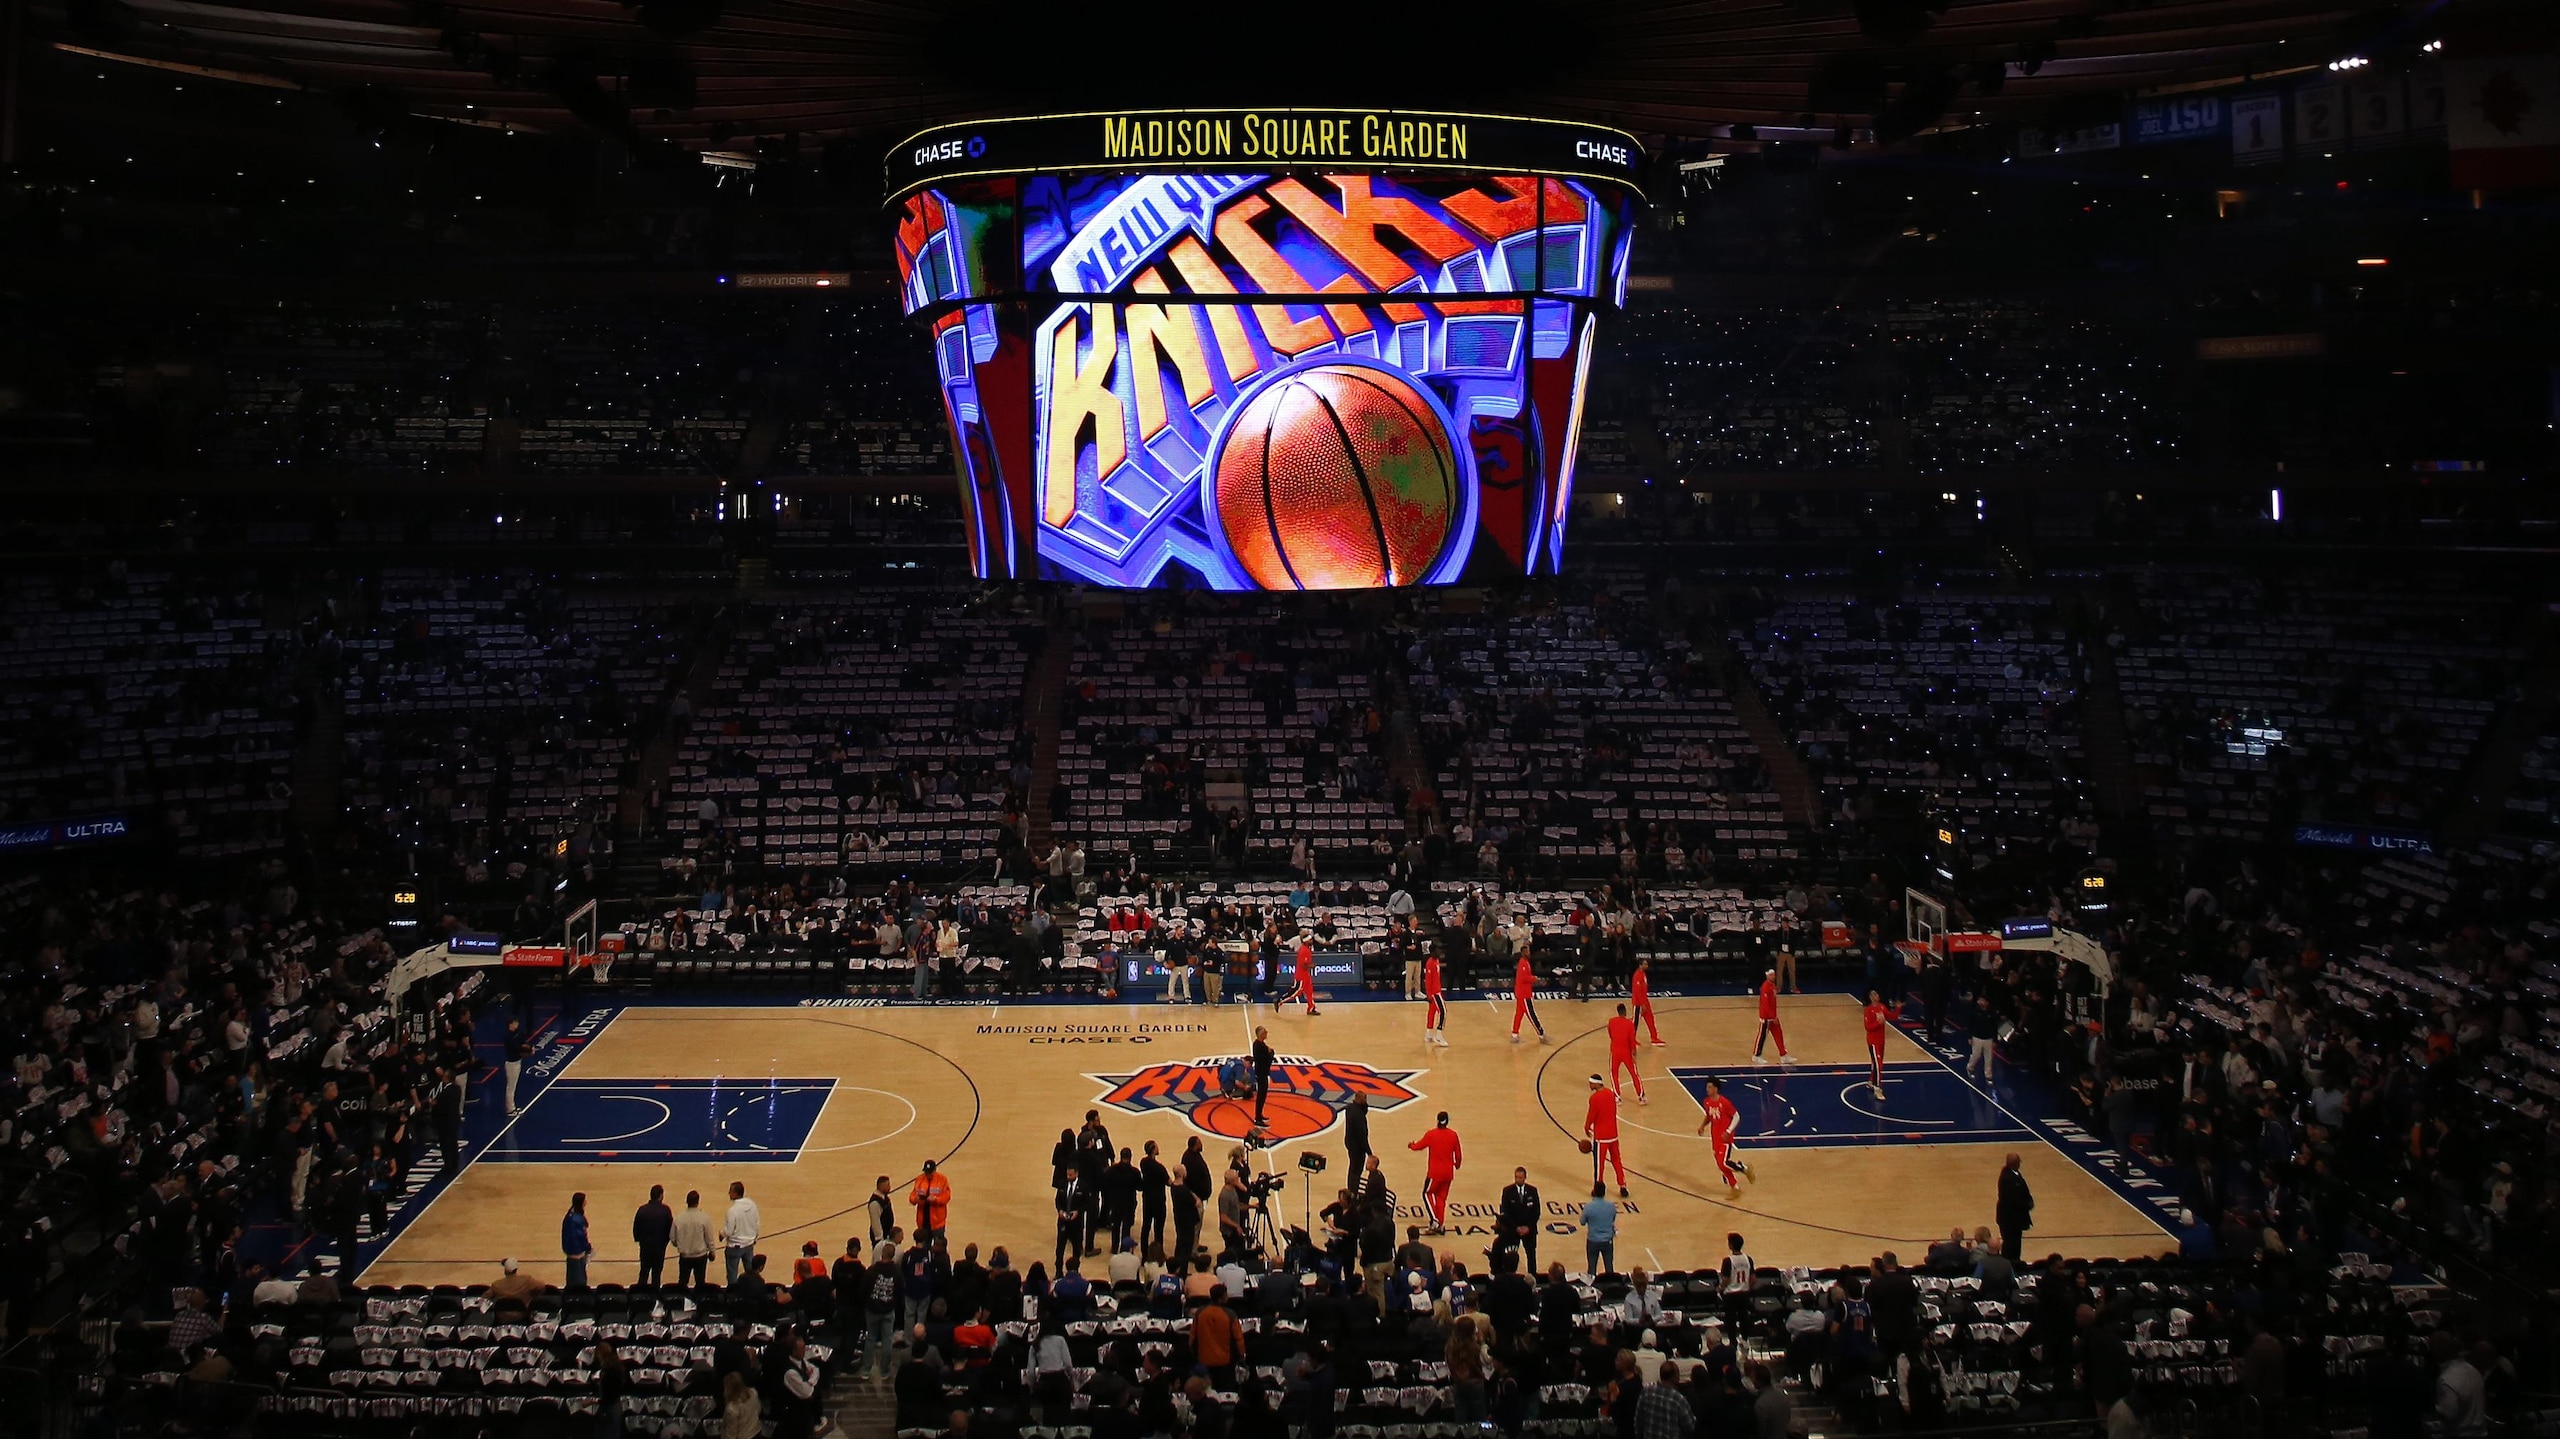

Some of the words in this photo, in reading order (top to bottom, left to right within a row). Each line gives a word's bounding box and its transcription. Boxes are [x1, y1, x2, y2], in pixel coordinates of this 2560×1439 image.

[2168, 97, 2219, 134] 150
[2309, 103, 2329, 139] 2
[1104, 117, 1231, 158] MADISON
[1243, 113, 1352, 159] SQUARE
[1363, 114, 1467, 159] GARDEN
[2250, 114, 2264, 147] 1
[915, 140, 963, 166] CHASE
[1576, 140, 1628, 166] CHASE
[759, 276, 807, 286] HYUNDAI
[67, 821, 125, 838] ULTRA
[2371, 835, 2432, 853] ULTRA
[1832, 928, 1840, 937] G
[607, 941, 615, 949] G
[1315, 963, 1352, 977] peacock
[812, 999, 888, 1007] PLAYOFFS
[1500, 991, 1569, 1000] PLOFFS
[567, 1007, 613, 1037] ULTRA
[976, 1025, 1057, 1034] MADISON
[1064, 1024, 1131, 1034] SQUARE
[1139, 1023, 1208, 1033] GARDEN
[1029, 1036, 1123, 1044] CHASE
[1103, 1062, 1418, 1105] KNCKS
[2040, 1118, 2102, 1143] NEW
[1737, 1270, 1746, 1284] 11
